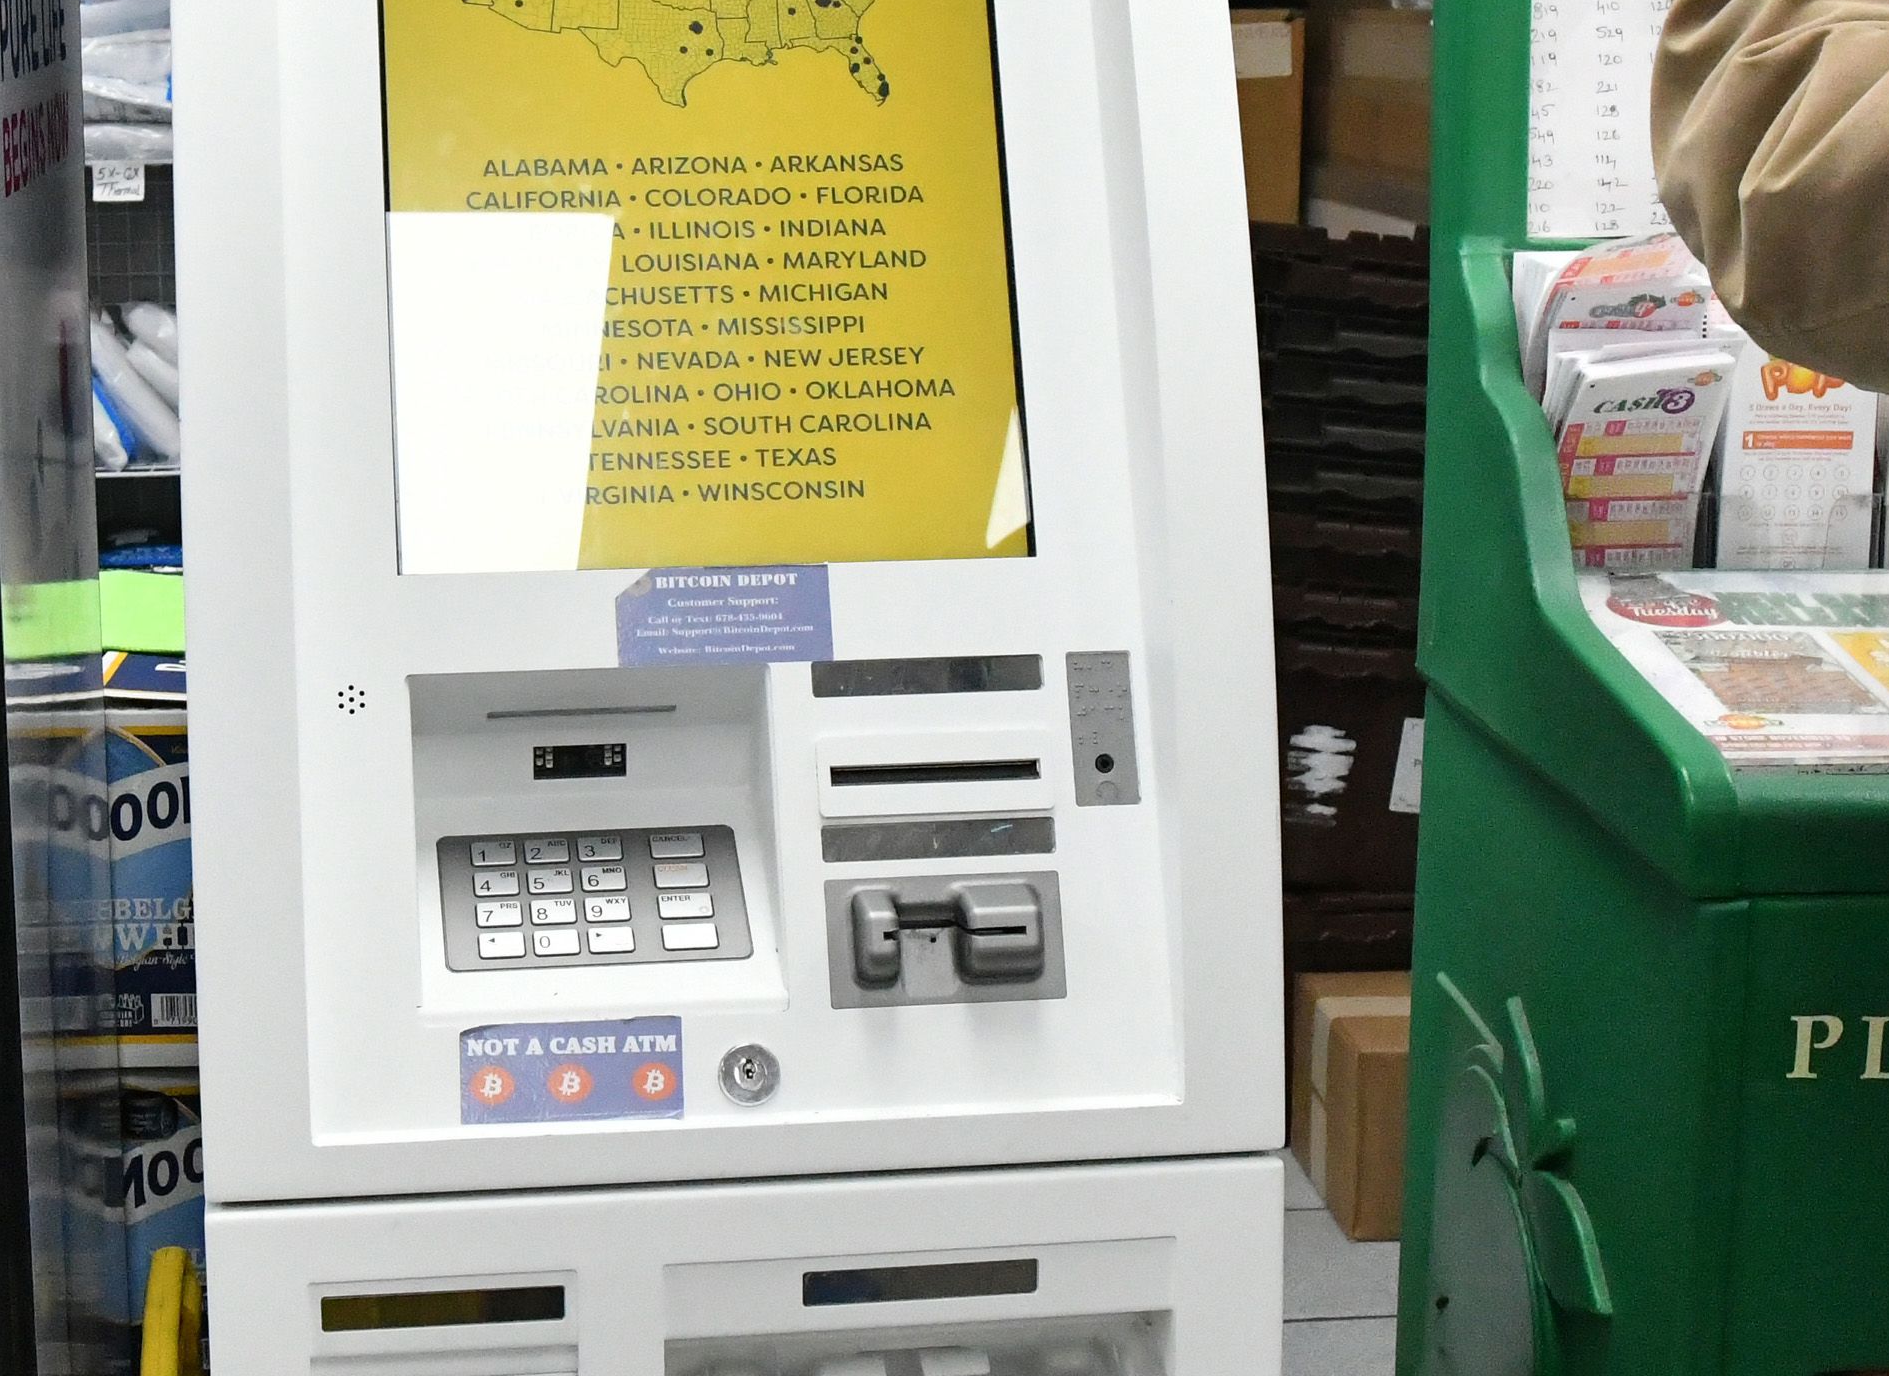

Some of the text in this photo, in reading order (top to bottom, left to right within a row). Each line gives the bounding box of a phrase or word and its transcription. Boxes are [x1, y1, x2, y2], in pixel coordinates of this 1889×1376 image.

[2, 101, 46, 198] BEGINS
[483, 154, 904, 177] ALABAMA ARIZONA ARKANSAS
[466, 185, 924, 210] CALIFORNIA COLORADO FLORIDA
[649, 218, 886, 240] ILLINOIS INDIANA
[622, 249, 927, 273] LOUISIANA MARYLAND
[605, 282, 888, 306] CHUSETTS MICHIGAN
[602, 315, 865, 338] NESOTA MISSISSIPPI
[637, 346, 925, 371] NEVADA NEW JERSEY
[595, 378, 956, 405] ROLINA OHIO OKLAHOMA
[703, 412, 932, 436] SOUTH CAROLINA
[589, 448, 837, 472] TENNESSEE TEXAS
[586, 485, 675, 506] RGINIA
[655, 572, 798, 589] BITCOIN DEPOT
[667, 596, 779, 609] Customer Support:
[647, 615, 669, 625] Call
[477, 850, 487, 863] 1
[529, 847, 543, 861] 2
[584, 844, 596, 858] 3
[479, 879, 492, 893] 4
[533, 877, 545, 890] 5
[587, 874, 600, 888] 6
[482, 909, 494, 924] 7
[536, 907, 549, 921] 8
[590, 904, 604, 918] 9
[539, 935, 551, 950] 0
[467, 1034, 677, 1056] NOT A CASH ATM
